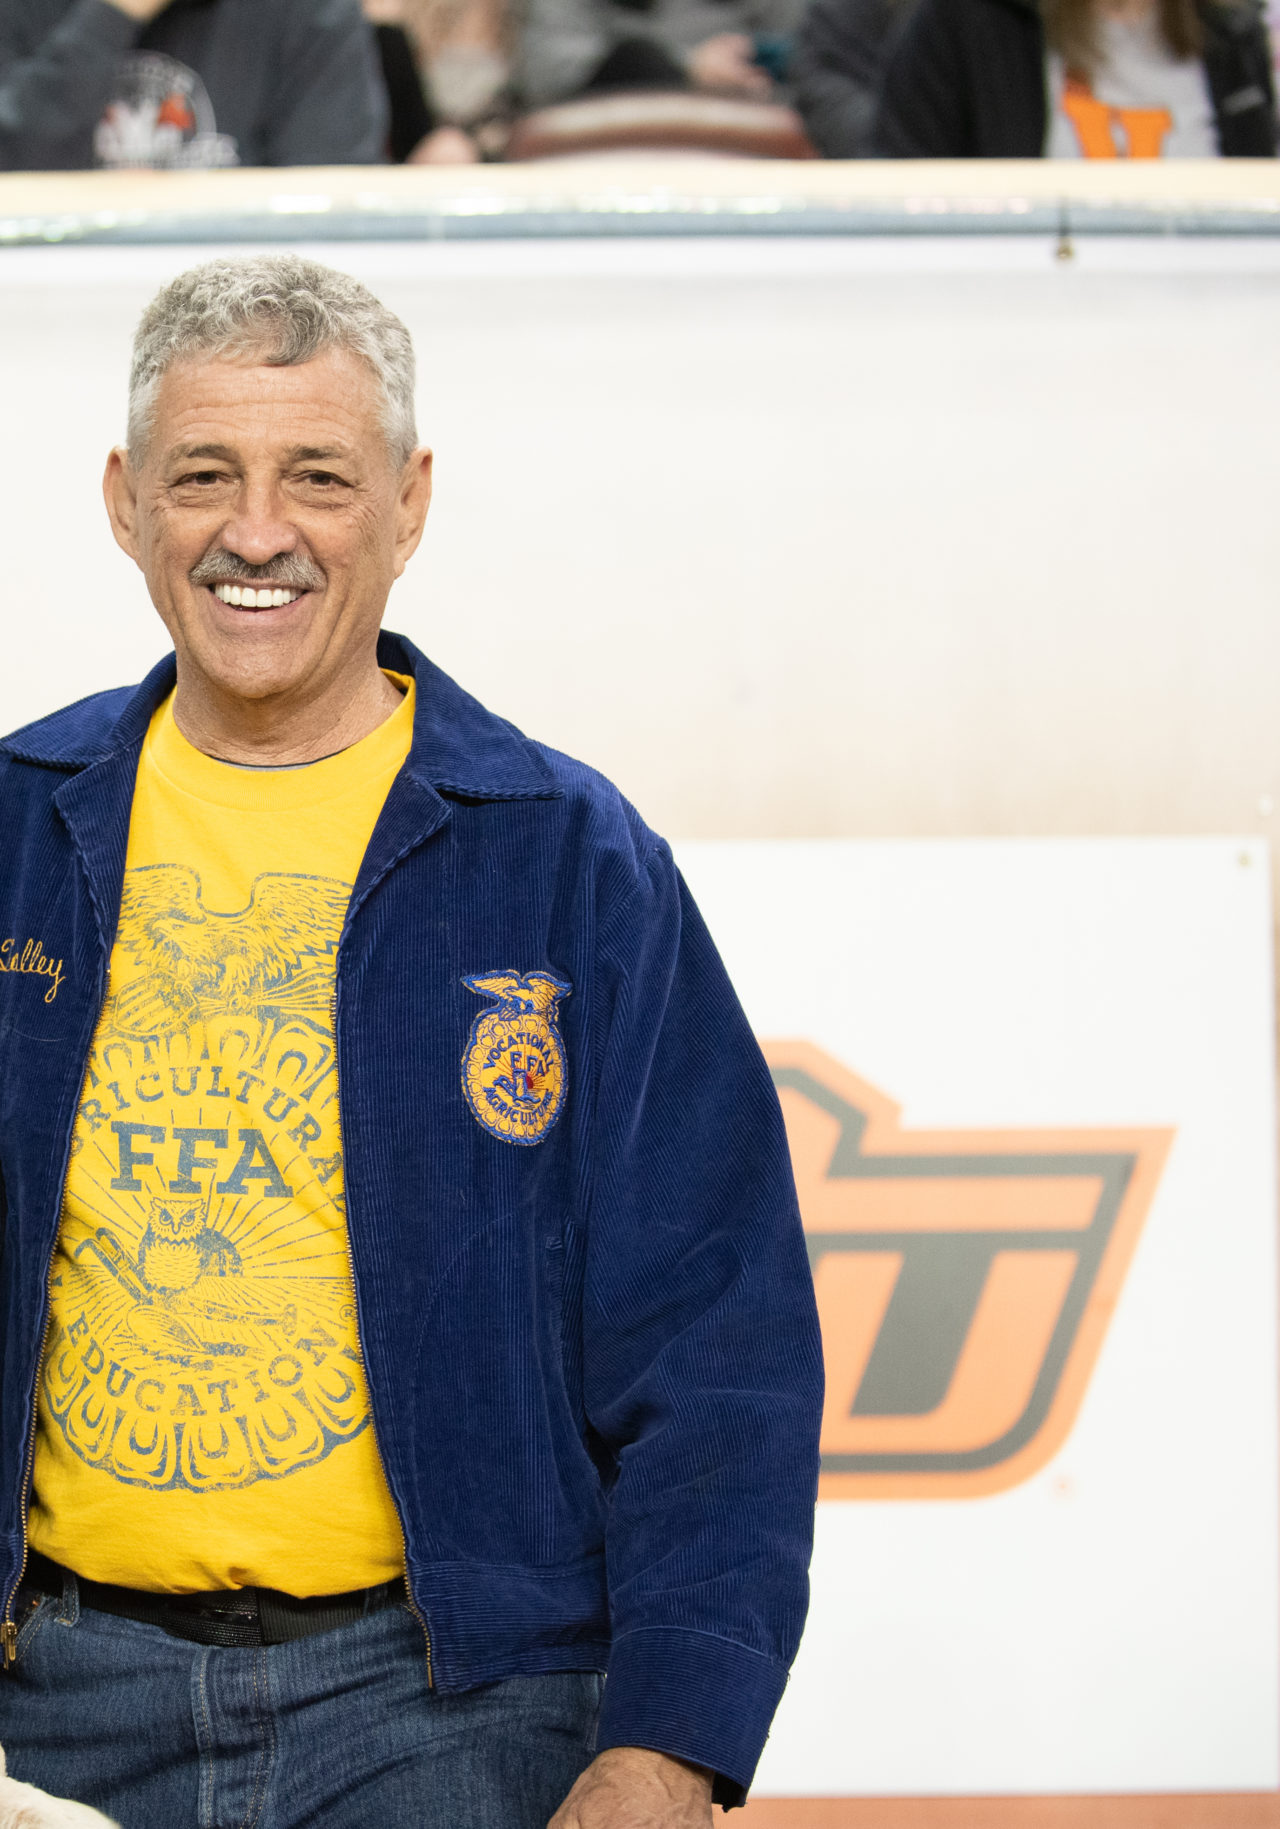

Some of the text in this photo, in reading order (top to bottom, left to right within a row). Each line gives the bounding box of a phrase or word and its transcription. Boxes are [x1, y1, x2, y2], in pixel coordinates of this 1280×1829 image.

[483, 1032, 554, 1072] VOCATIONAL
[510, 1051, 545, 1077] FFA
[111, 1120, 293, 1197] FFA
[67, 1310, 339, 1416] EDUCATION
